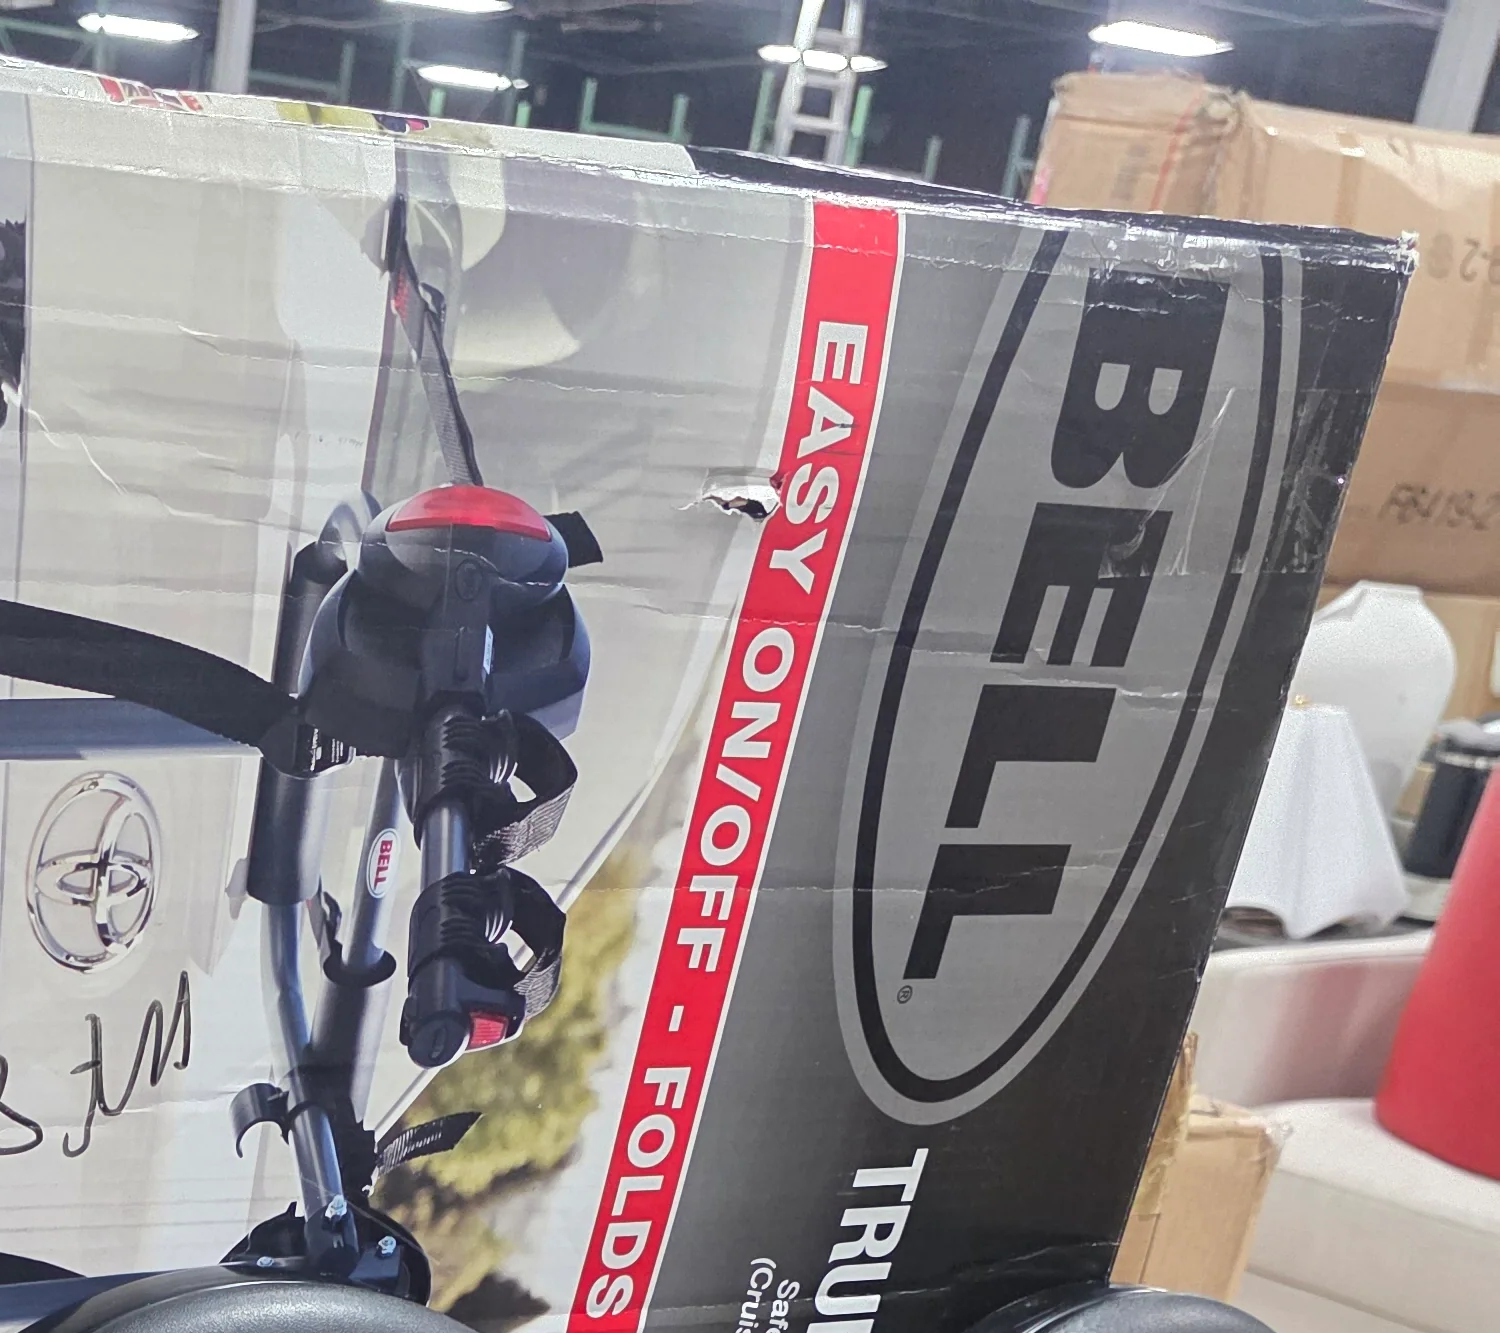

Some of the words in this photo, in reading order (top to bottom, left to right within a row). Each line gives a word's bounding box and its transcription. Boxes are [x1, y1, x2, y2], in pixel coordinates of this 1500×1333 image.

[766, 319, 869, 595] EASY
[902, 266, 1231, 980] BELL
[373, 839, 393, 890] BELL
[677, 626, 797, 973] ON/OFF
[584, 1065, 692, 1319] FOLDS
